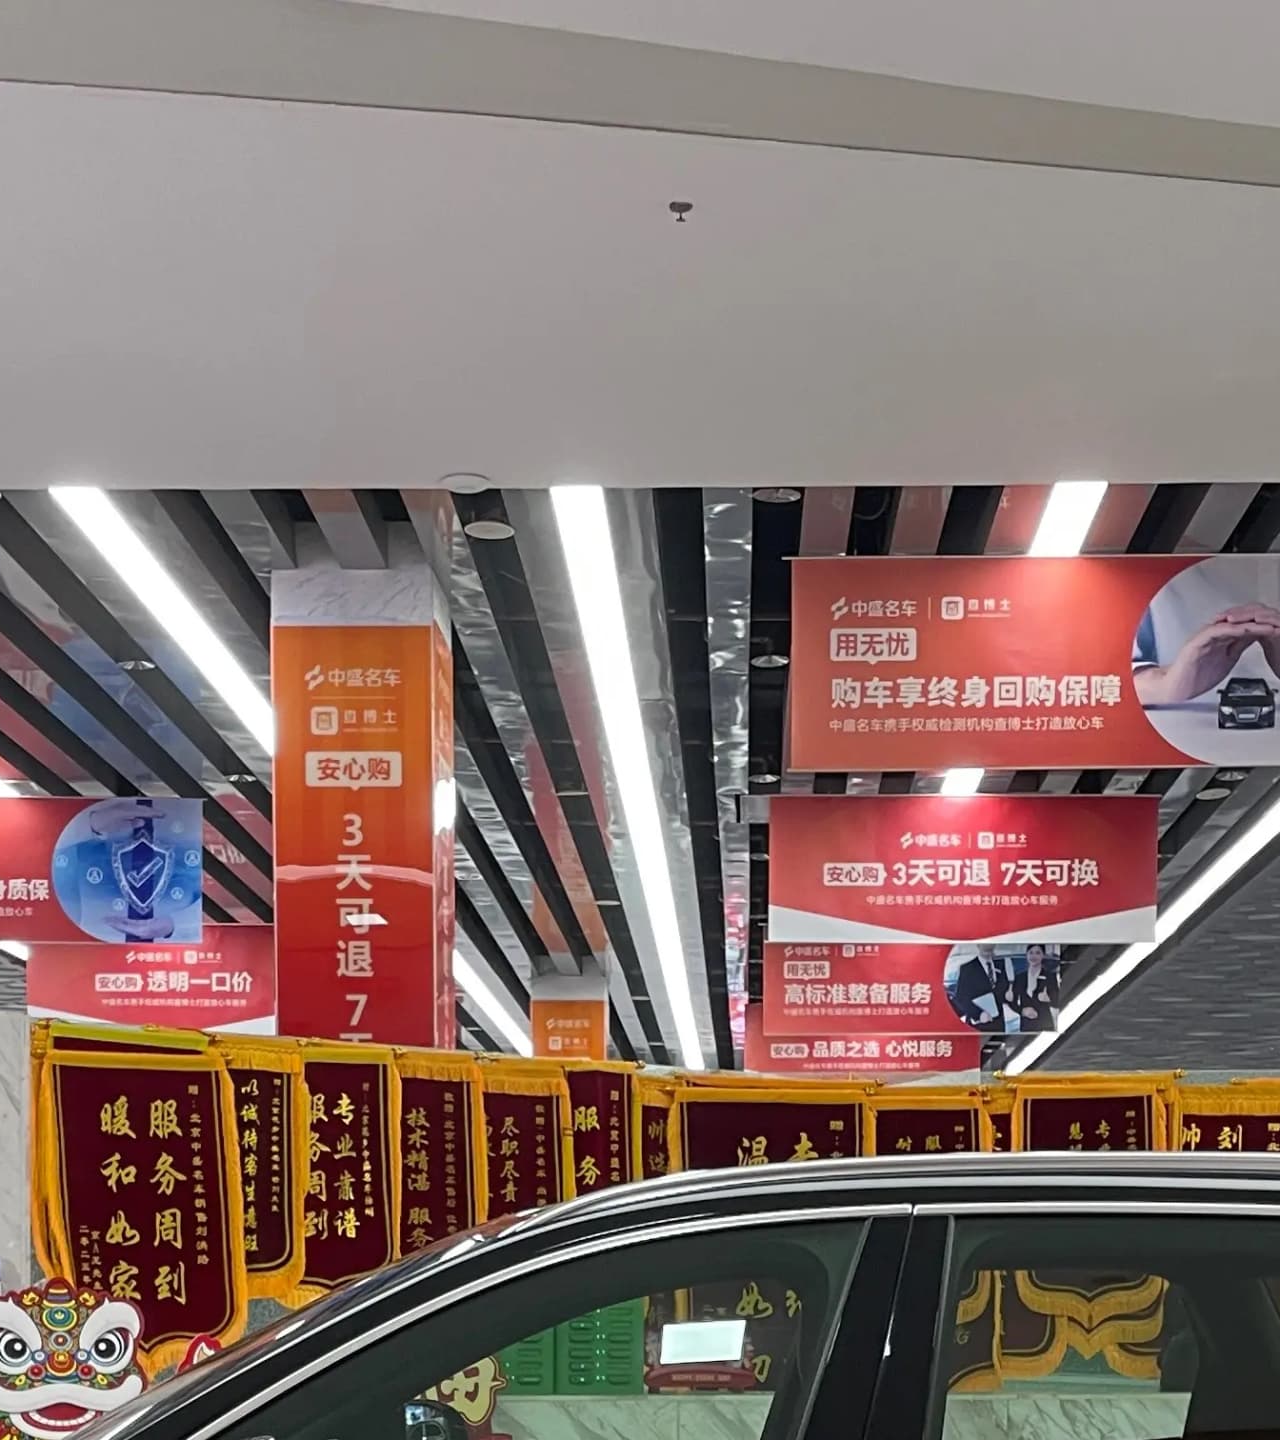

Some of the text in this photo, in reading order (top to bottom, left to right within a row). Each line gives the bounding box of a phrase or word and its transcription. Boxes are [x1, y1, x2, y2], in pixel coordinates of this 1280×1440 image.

[852, 600, 917, 617] 中盛名车
[835, 633, 909, 657] 用无忧
[328, 668, 401, 687] 中盛名车
[831, 676, 1122, 709] 购车享终身回购保障
[317, 758, 390, 780] 安心购
[915, 834, 961, 846] 中盛名车
[827, 860, 1099, 886] 安心购 3天可退 7天可换
[336, 813, 374, 978] 3天可退
[98, 971, 253, 993] 安心购 透明一口价
[785, 984, 931, 1004] 高标准整备服务
[813, 1041, 880, 1058] 品质之选
[886, 1041, 952, 1057] 心悦服务
[574, 1106, 601, 1185] 服务
[500, 1117, 520, 1202] 尽职尽责
[100, 1096, 141, 1300] 暖和如家
[149, 1100, 187, 1305] 服务周到
